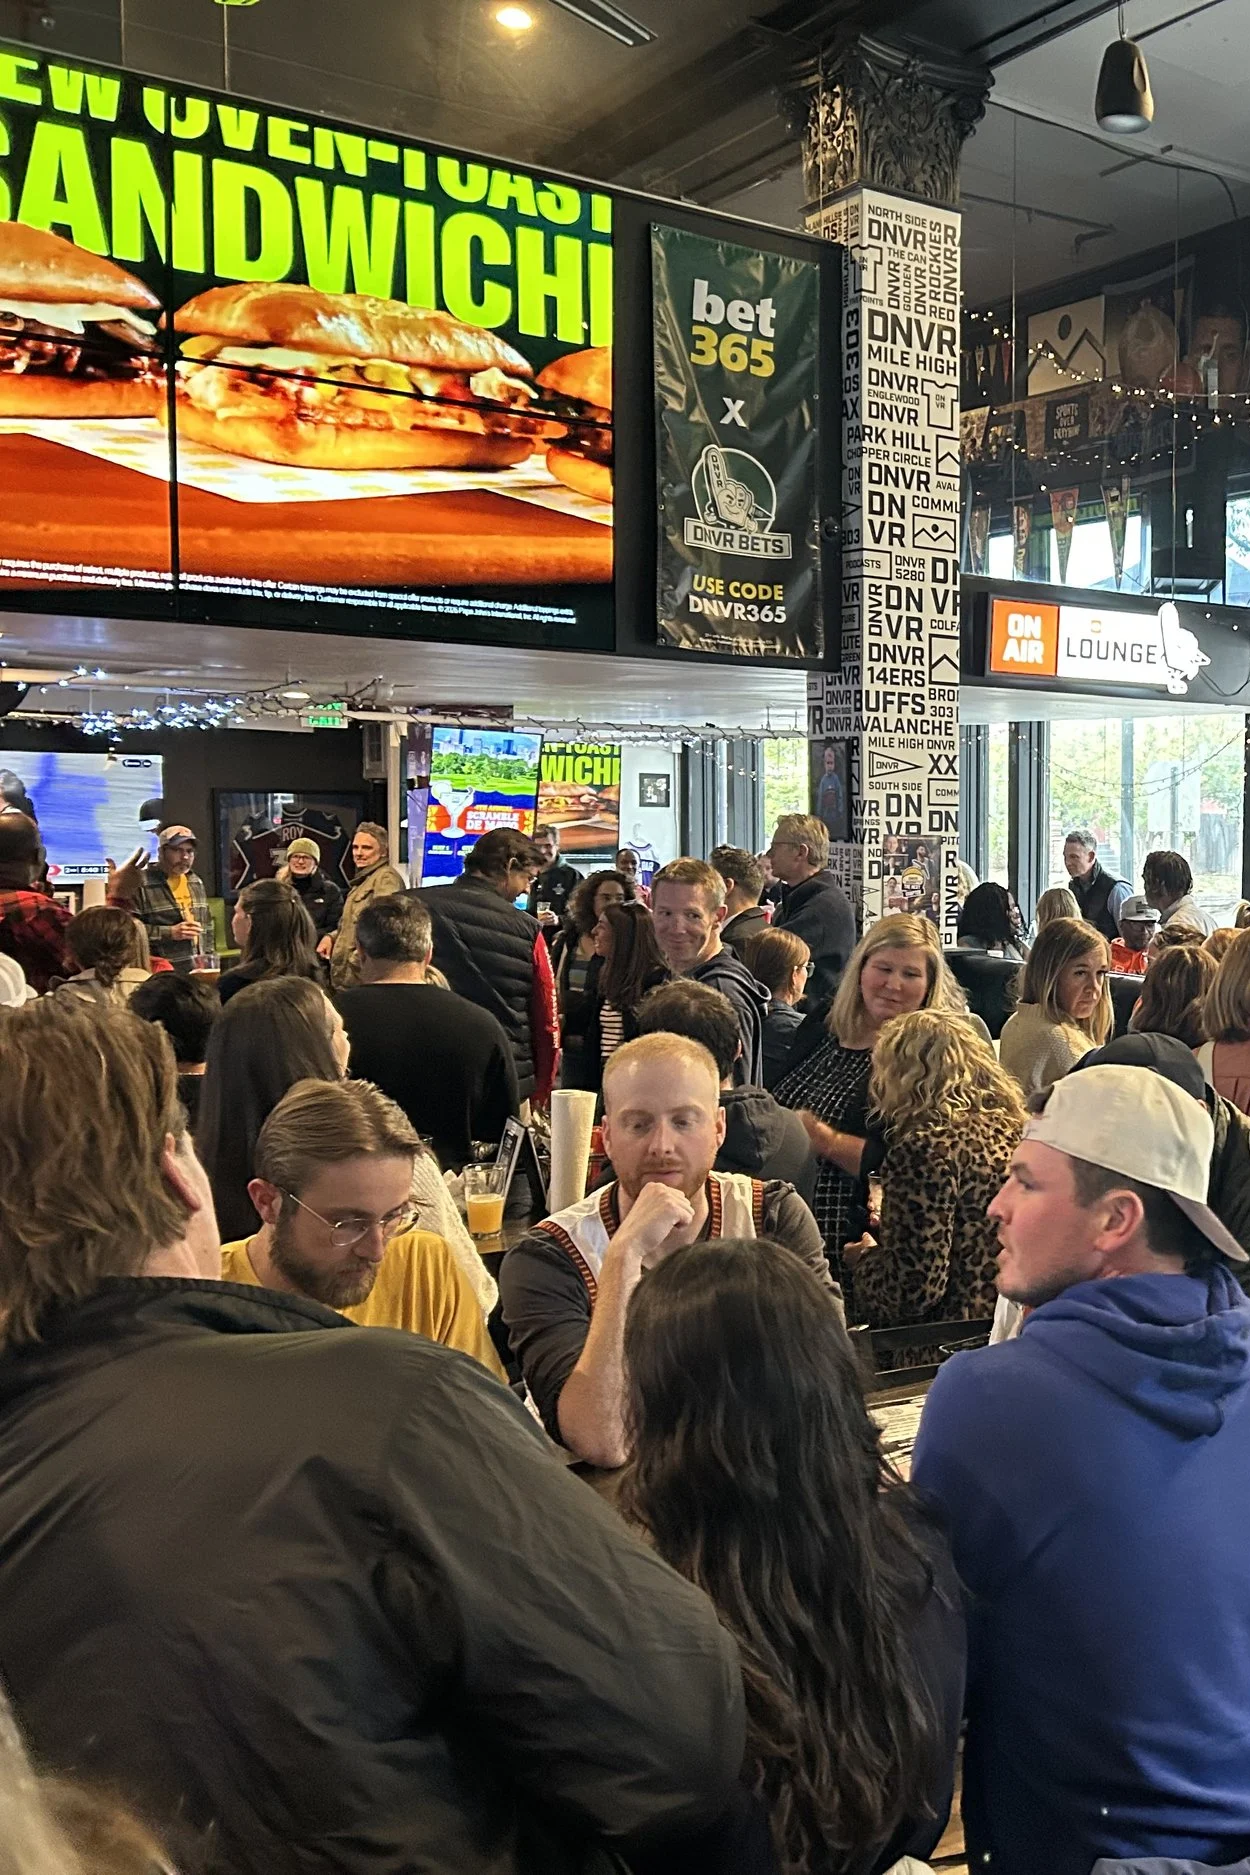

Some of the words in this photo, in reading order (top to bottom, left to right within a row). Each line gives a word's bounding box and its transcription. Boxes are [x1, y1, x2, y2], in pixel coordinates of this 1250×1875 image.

[868, 204, 902, 222] NORTH
[905, 214, 927, 228] SIDE
[868, 218, 926, 252] DNVR
[887, 247, 905, 260] THE
[908, 252, 927, 264] CAN
[930, 221, 941, 301] ROCKIES
[888, 262, 900, 309] DNVR
[903, 264, 911, 311] GOLDEN
[943, 250, 957, 305] DNVR
[915, 267, 926, 315] DNVR
[693, 279, 776, 337] bet
[930, 306, 955, 322] RED
[846, 308, 859, 371] 303
[868, 308, 956, 357] DNVR
[691, 326, 775, 377] 365
[868, 344, 909, 367] MILE
[916, 353, 956, 377] HIGH
[868, 367, 918, 394] DNVR
[868, 390, 920, 405] ENGLEWOOD
[1056, 403, 1078, 417] SPORTS
[869, 401, 918, 426] DNVR
[1060, 416, 1074, 427] OVER
[848, 425, 887, 445] PARK
[892, 431, 931, 452] HILL
[847, 448, 890, 461] CHOPPER
[893, 452, 931, 468] CIRCLE
[711, 455, 723, 488] DNVR
[869, 463, 930, 492] DNVR
[869, 490, 905, 520] DN
[694, 526, 734, 548] DNVR
[739, 536, 784, 554] BETS
[868, 520, 905, 547] VR
[846, 558, 881, 570] PODCASTS
[896, 556, 925, 569] DNVR
[693, 574, 724, 596] USE
[729, 581, 783, 600] CODE
[896, 569, 924, 582] 5280
[689, 595, 786, 624] DNVR365
[869, 584, 882, 636] DNVR
[886, 585, 923, 613] DN
[886, 614, 923, 641] VR
[1008, 613, 1041, 638] ON
[869, 643, 924, 666] DNVR
[1003, 639, 1044, 664] AIR
[1066, 637, 1157, 665] LOUNGE
[867, 667, 925, 687] 14ERS
[854, 690, 925, 715] BUFFS
[930, 706, 953, 718] 303
[854, 716, 953, 736] AVALANCHE
[869, 737, 896, 748] MILE
[898, 738, 923, 749] HIGH
[927, 740, 955, 750] DNVR
[869, 781, 900, 791] SOUTH
[902, 782, 922, 791] SIDE
[466, 811, 519, 820] SCRAMBLE
[886, 794, 922, 817] DN
[282, 826, 303, 841] ROY
[465, 820, 482, 830] DE
